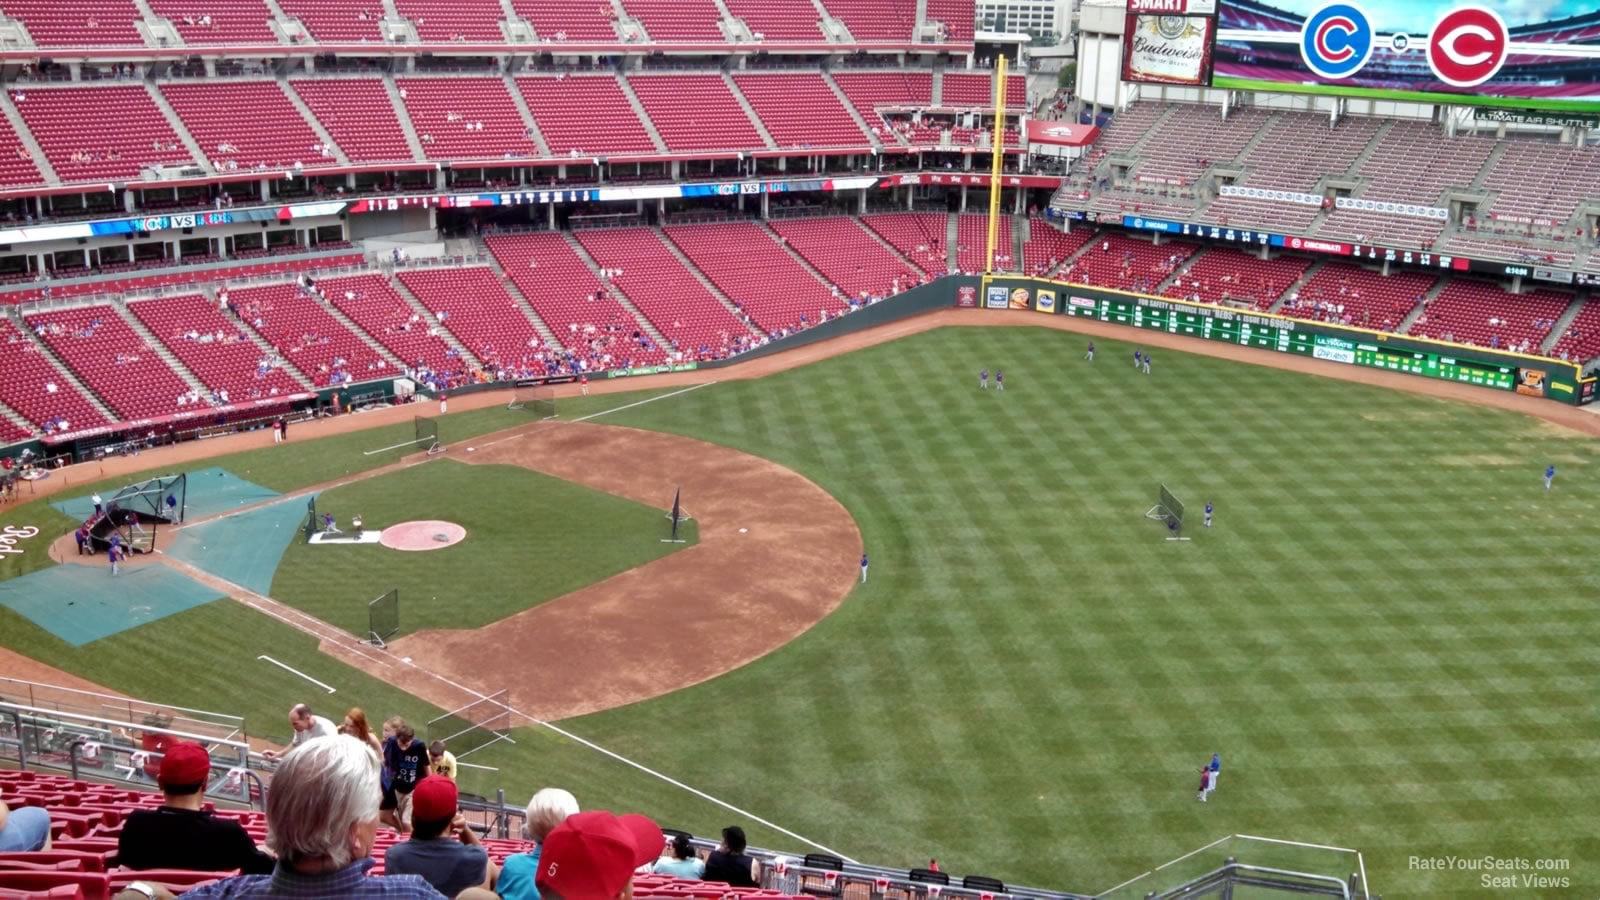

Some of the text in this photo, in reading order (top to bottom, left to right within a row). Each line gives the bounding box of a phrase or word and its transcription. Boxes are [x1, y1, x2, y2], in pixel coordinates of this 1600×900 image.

[1131, 0, 1182, 10] SMART
[1133, 36, 1201, 60] Budweiser
[1475, 112, 1594, 128] ULTIMATE AIR SHUTTLE
[743, 185, 757, 193] VS
[173, 215, 193, 227] VS
[1150, 300, 1169, 309] SAFETY
[1199, 307, 1211, 315] TEXT
[0, 525, 39, 559] Red
[547, 861, 559, 877] 5
